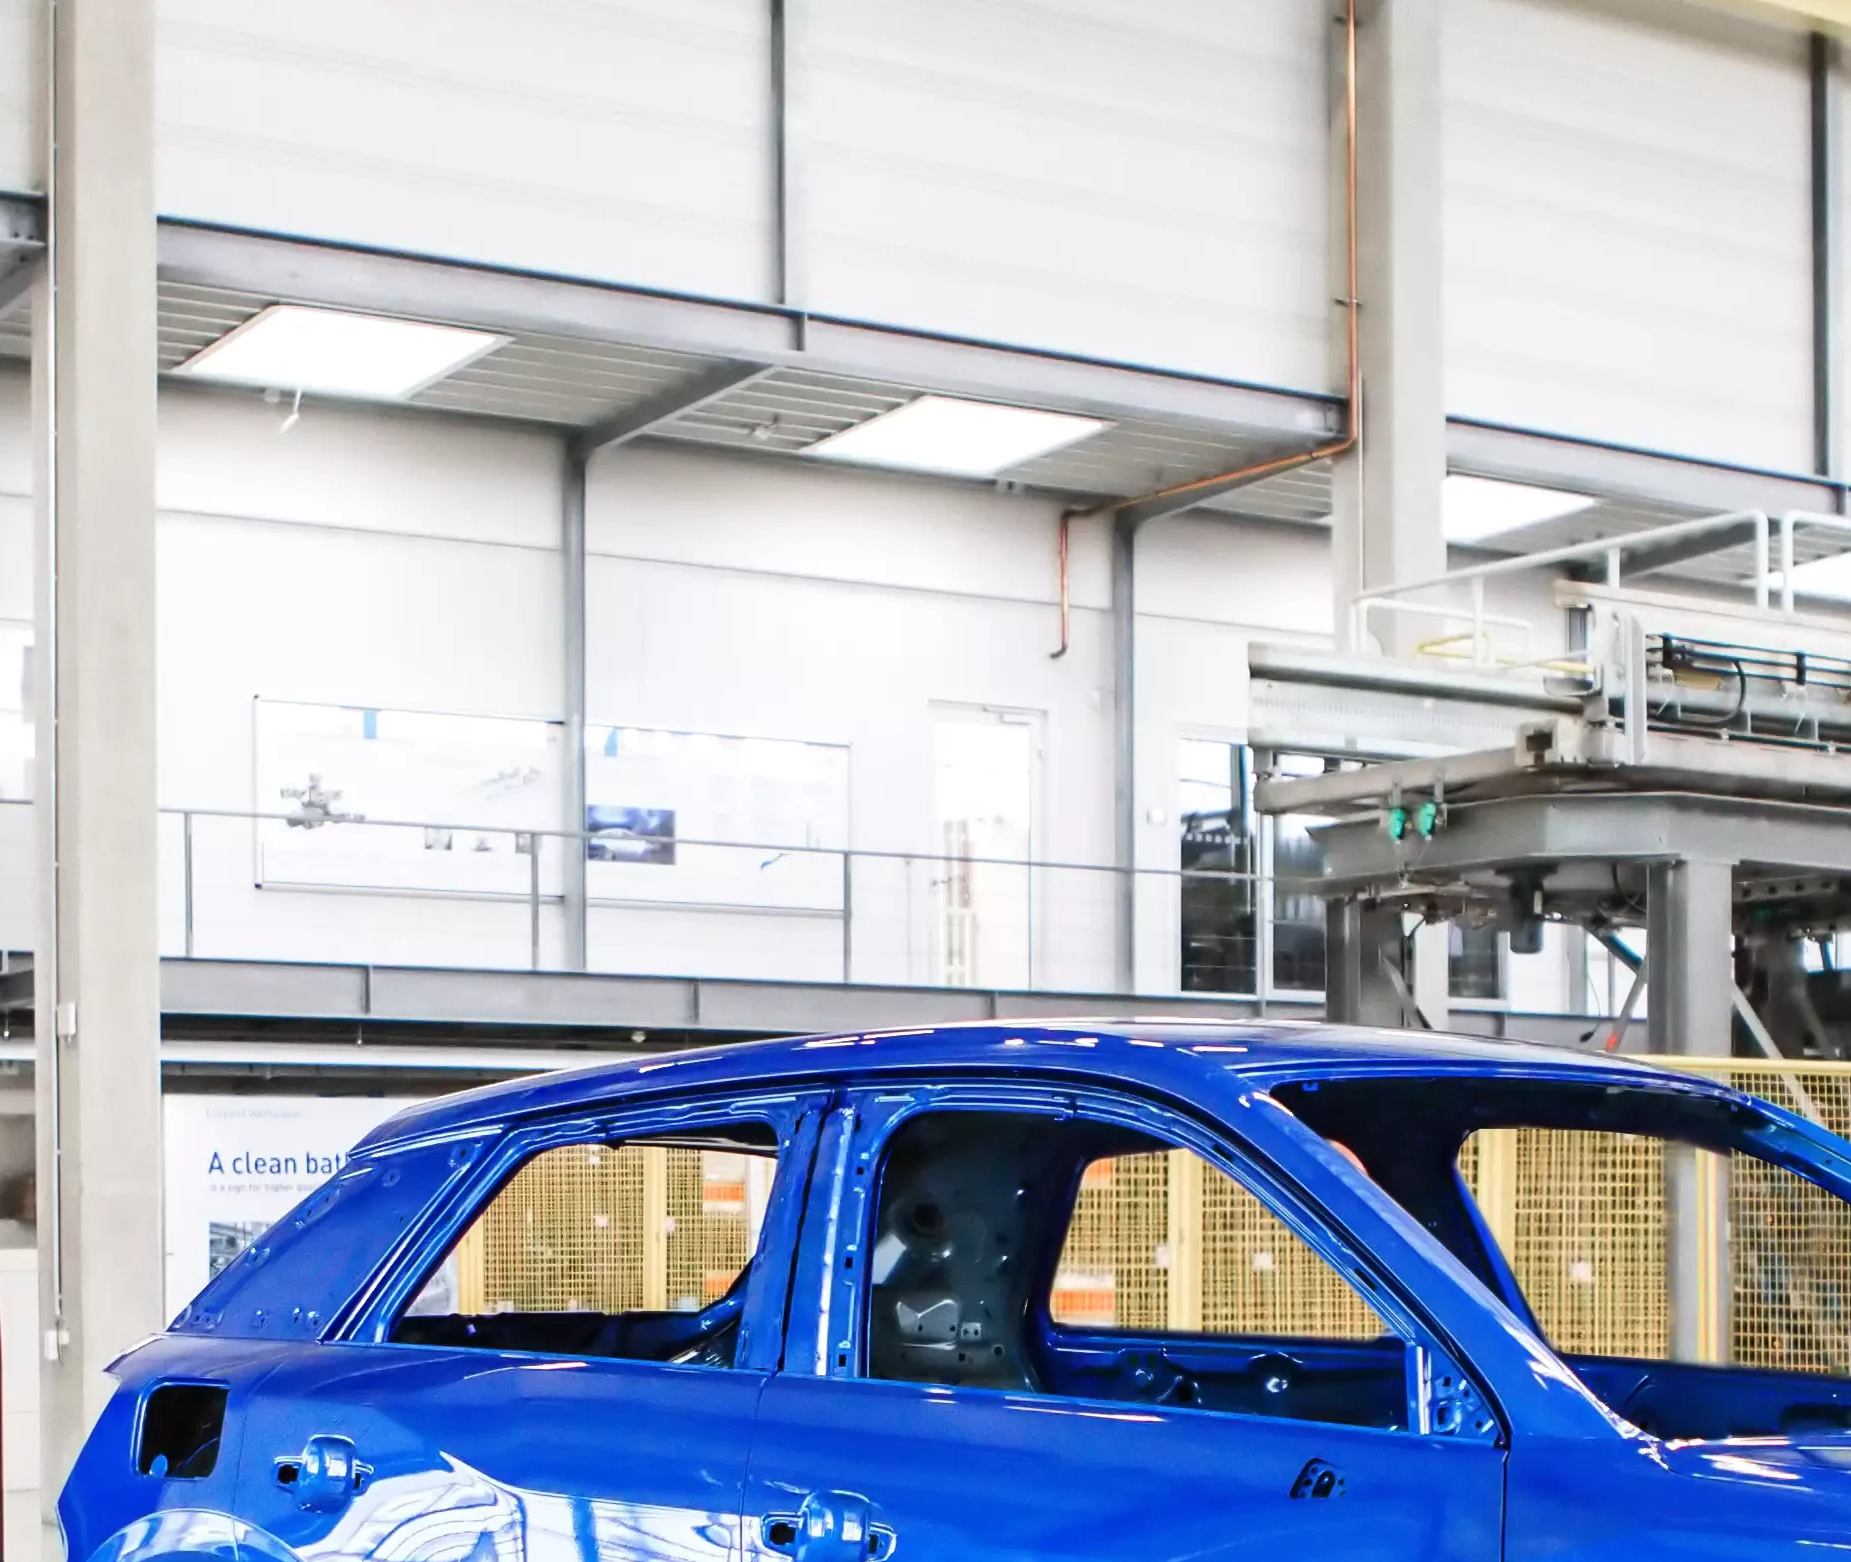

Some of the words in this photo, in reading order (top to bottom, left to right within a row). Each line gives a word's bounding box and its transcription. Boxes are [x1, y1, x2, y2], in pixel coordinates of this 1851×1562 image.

[208, 1151, 224, 1174] A
[232, 1151, 297, 1174] clean
[306, 1151, 350, 1174] bat
